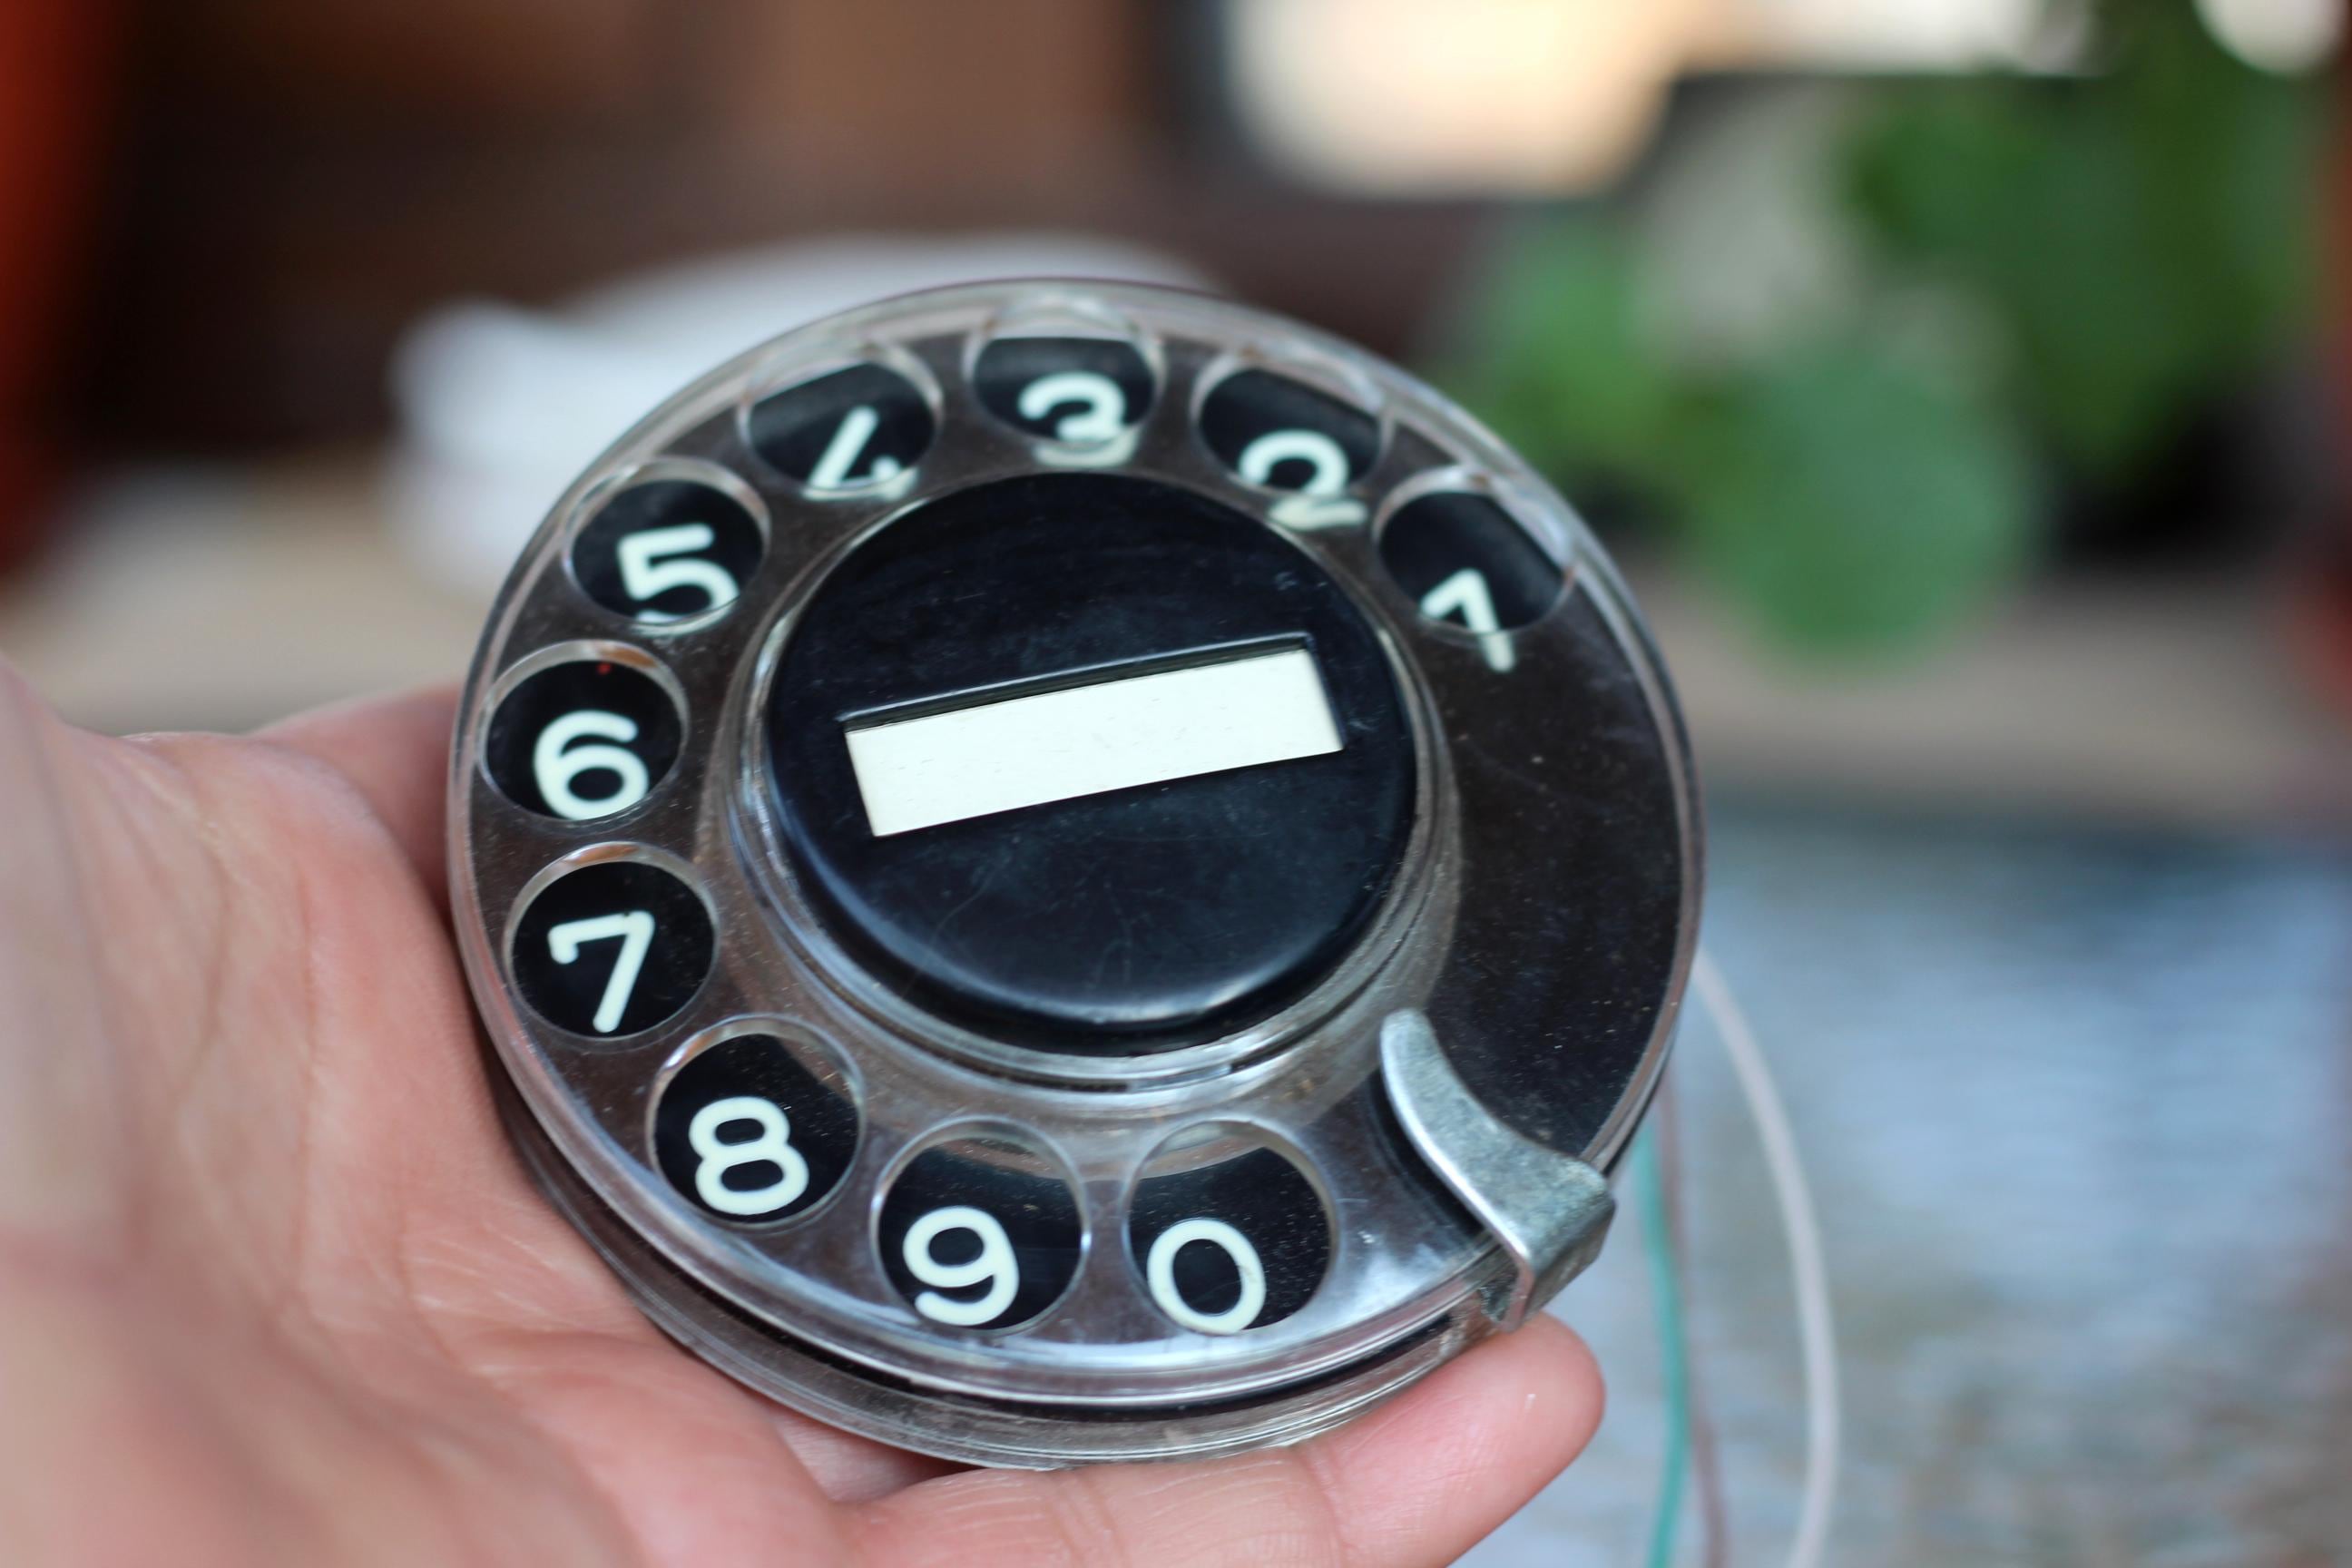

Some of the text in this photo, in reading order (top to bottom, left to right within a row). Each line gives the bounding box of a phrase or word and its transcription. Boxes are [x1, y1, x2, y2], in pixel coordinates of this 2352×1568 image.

[1018, 373, 1139, 468] 3
[1238, 430, 1366, 532] 2
[619, 524, 739, 627] 5
[1419, 569, 1517, 671] 1
[535, 710, 649, 821] 6
[548, 909, 655, 1034] 7
[690, 1094, 809, 1216] 8
[902, 1205, 1020, 1328] 9
[1147, 1218, 1266, 1334] 0
